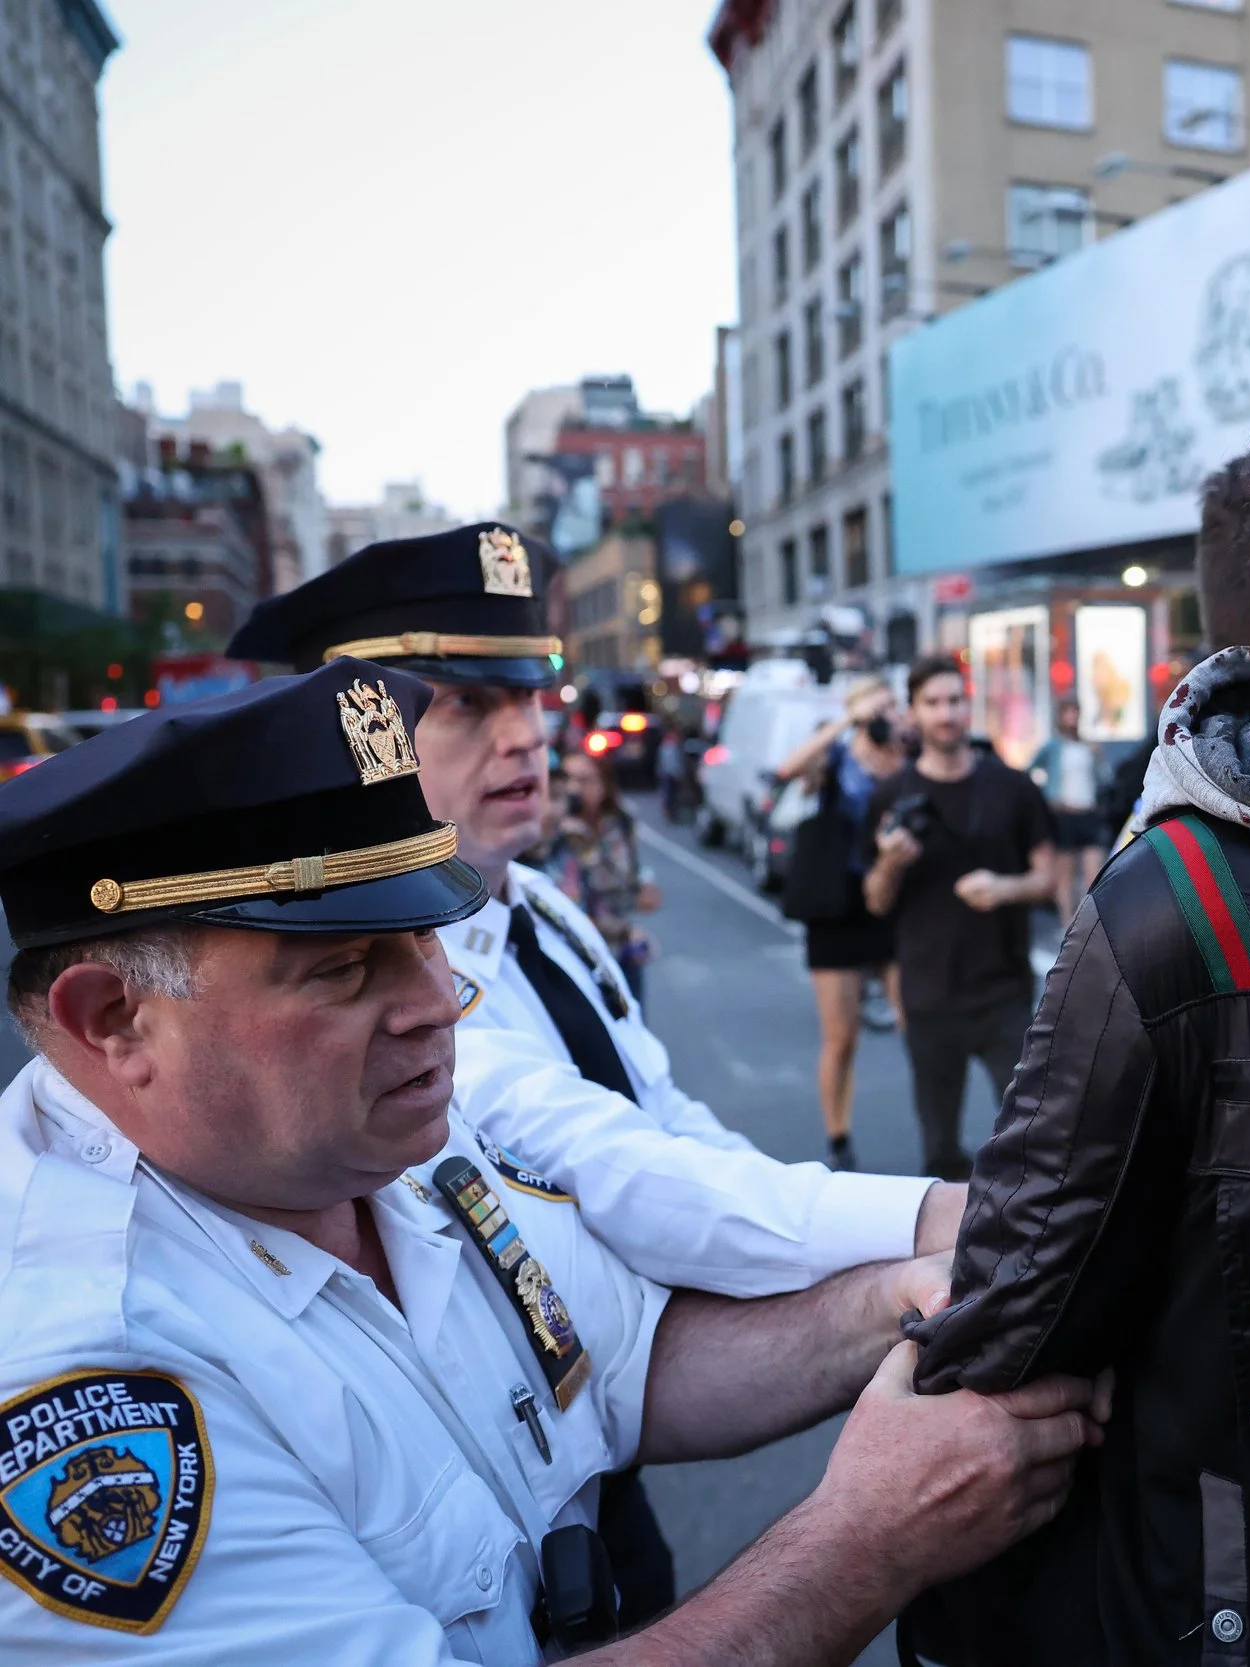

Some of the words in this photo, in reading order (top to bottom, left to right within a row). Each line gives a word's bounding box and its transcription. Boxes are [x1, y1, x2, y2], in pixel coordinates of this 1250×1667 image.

[517, 1170, 553, 1190] CITY
[7, 1383, 133, 1443] POLICE
[148, 1518, 189, 1583] NEW
[174, 1442, 198, 1511] YORK
[0, 1527, 61, 1580] CITY
[61, 1573, 107, 1601] OF
